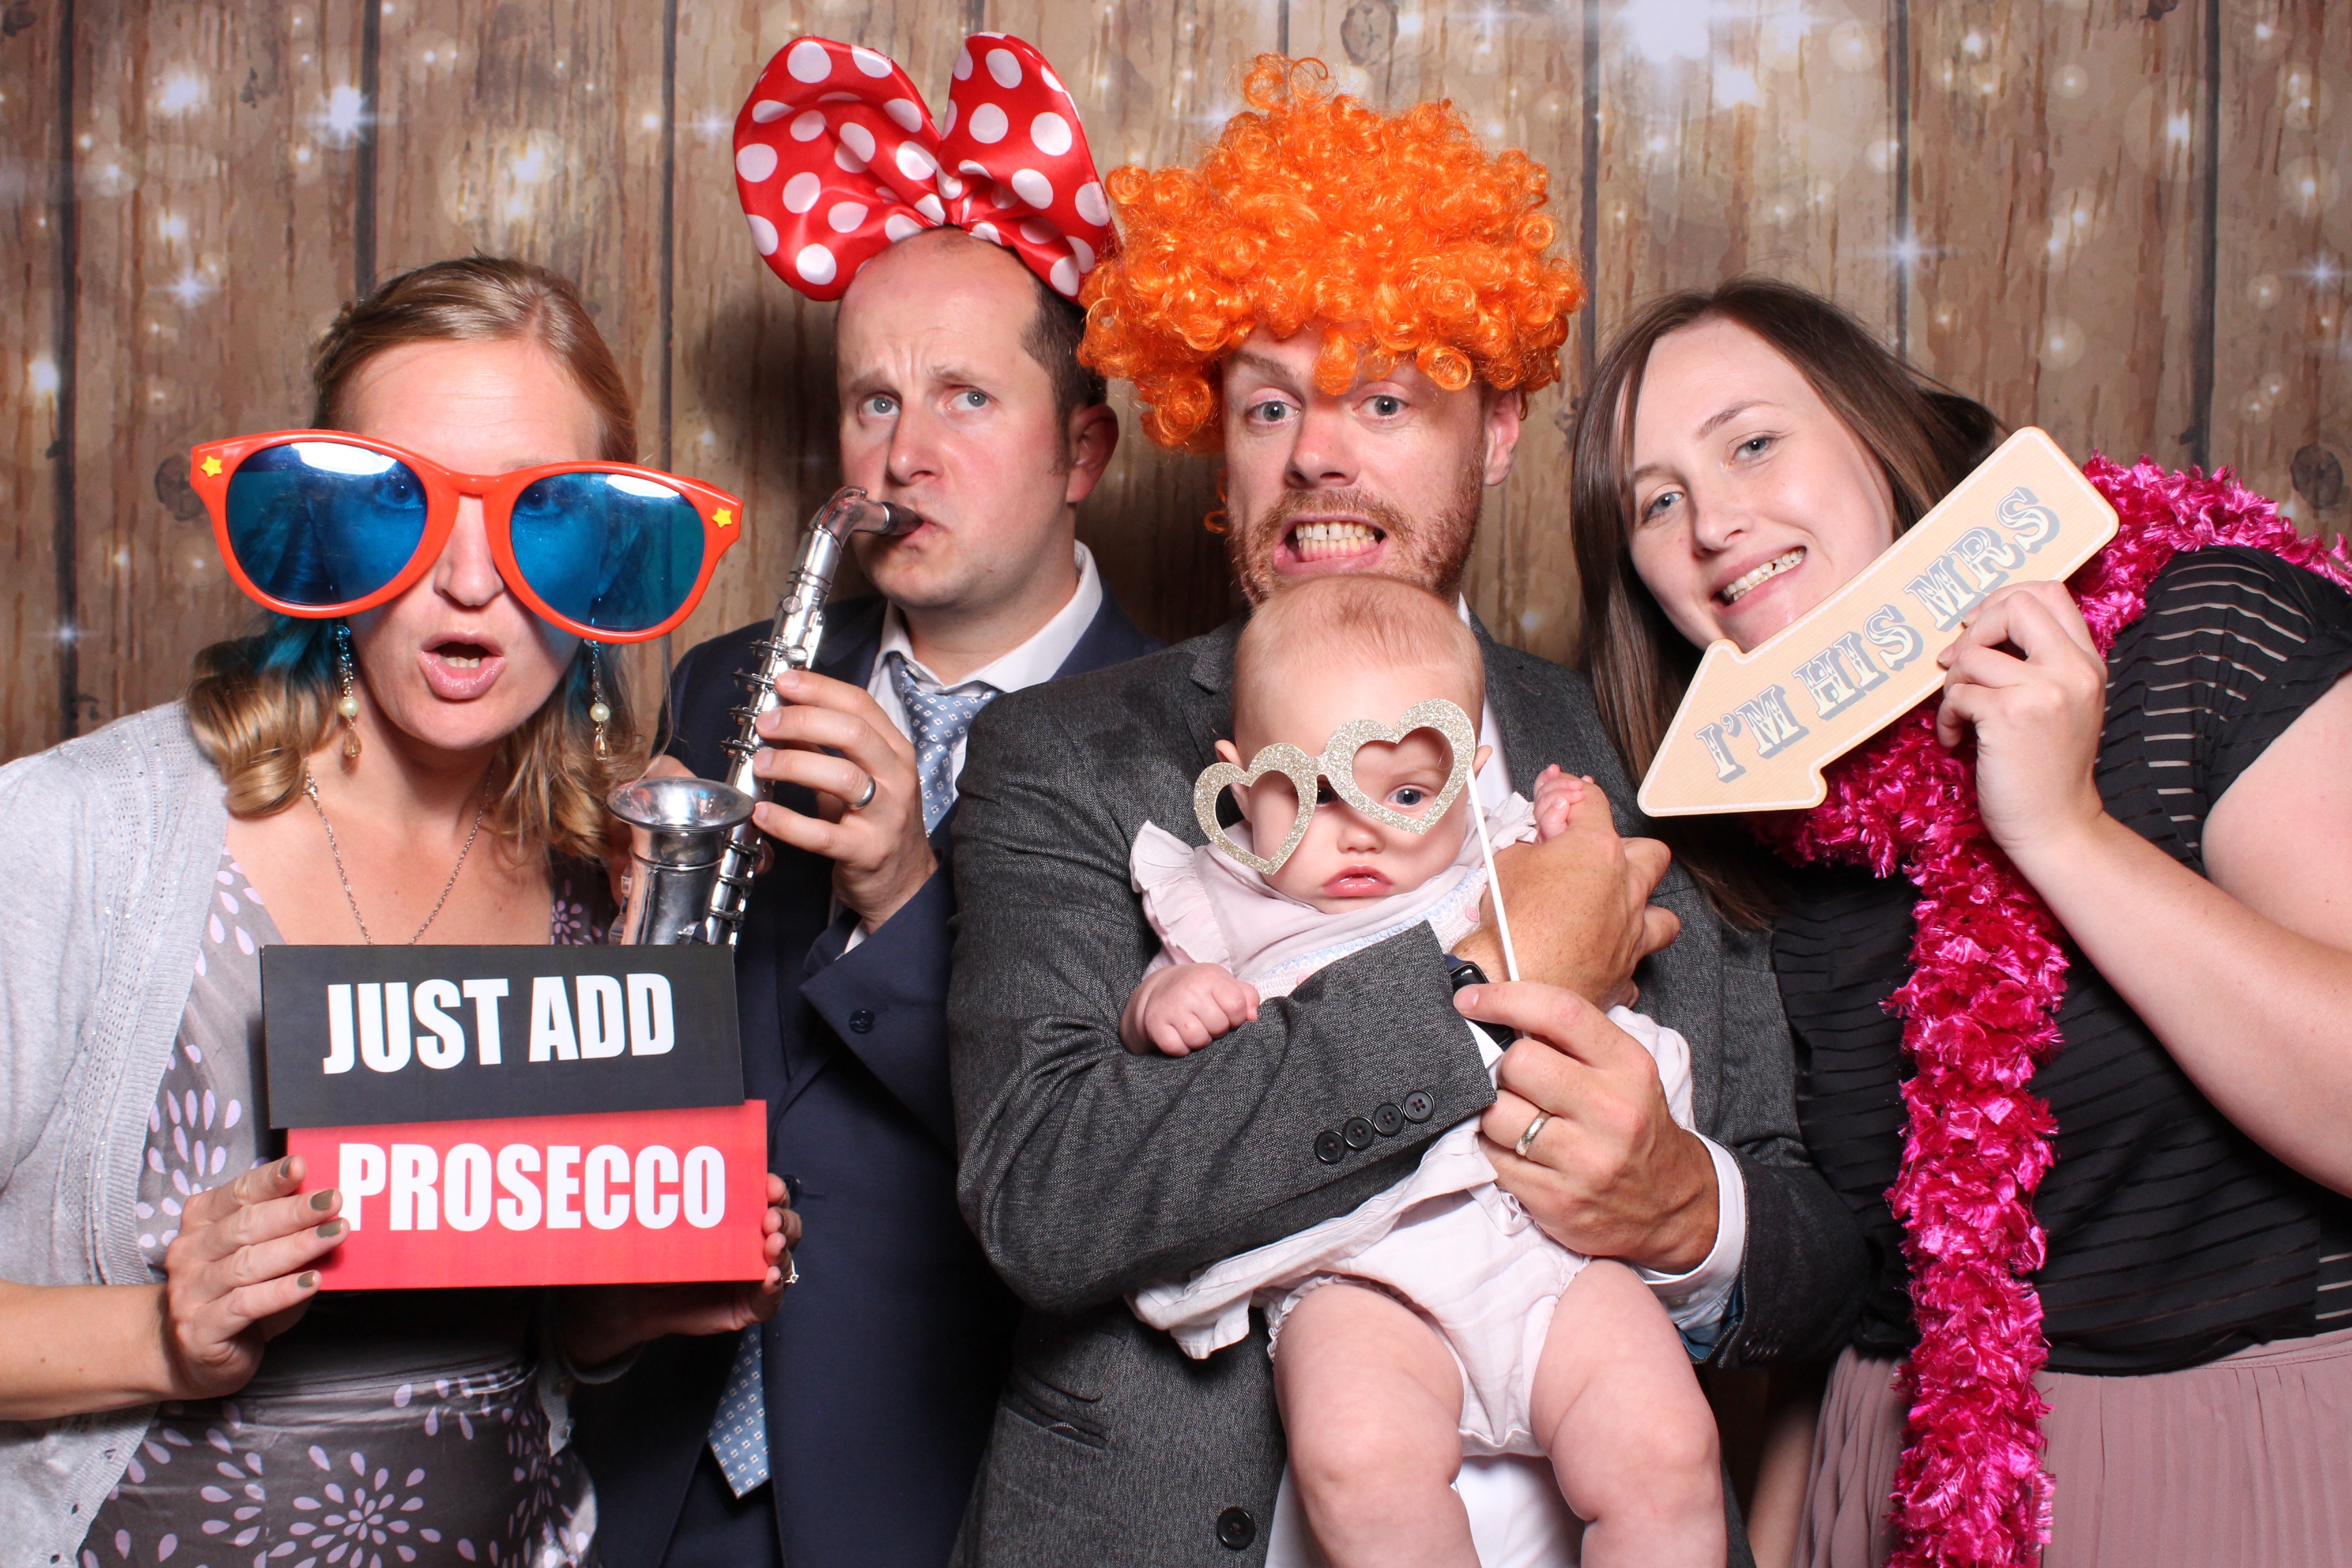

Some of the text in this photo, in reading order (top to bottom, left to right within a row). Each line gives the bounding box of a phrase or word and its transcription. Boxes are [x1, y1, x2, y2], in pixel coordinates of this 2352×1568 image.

[1695, 486, 2060, 783] I'M HIS MRS
[323, 973, 675, 1075] JUST ADD
[338, 1142, 726, 1232] PROSECCO
